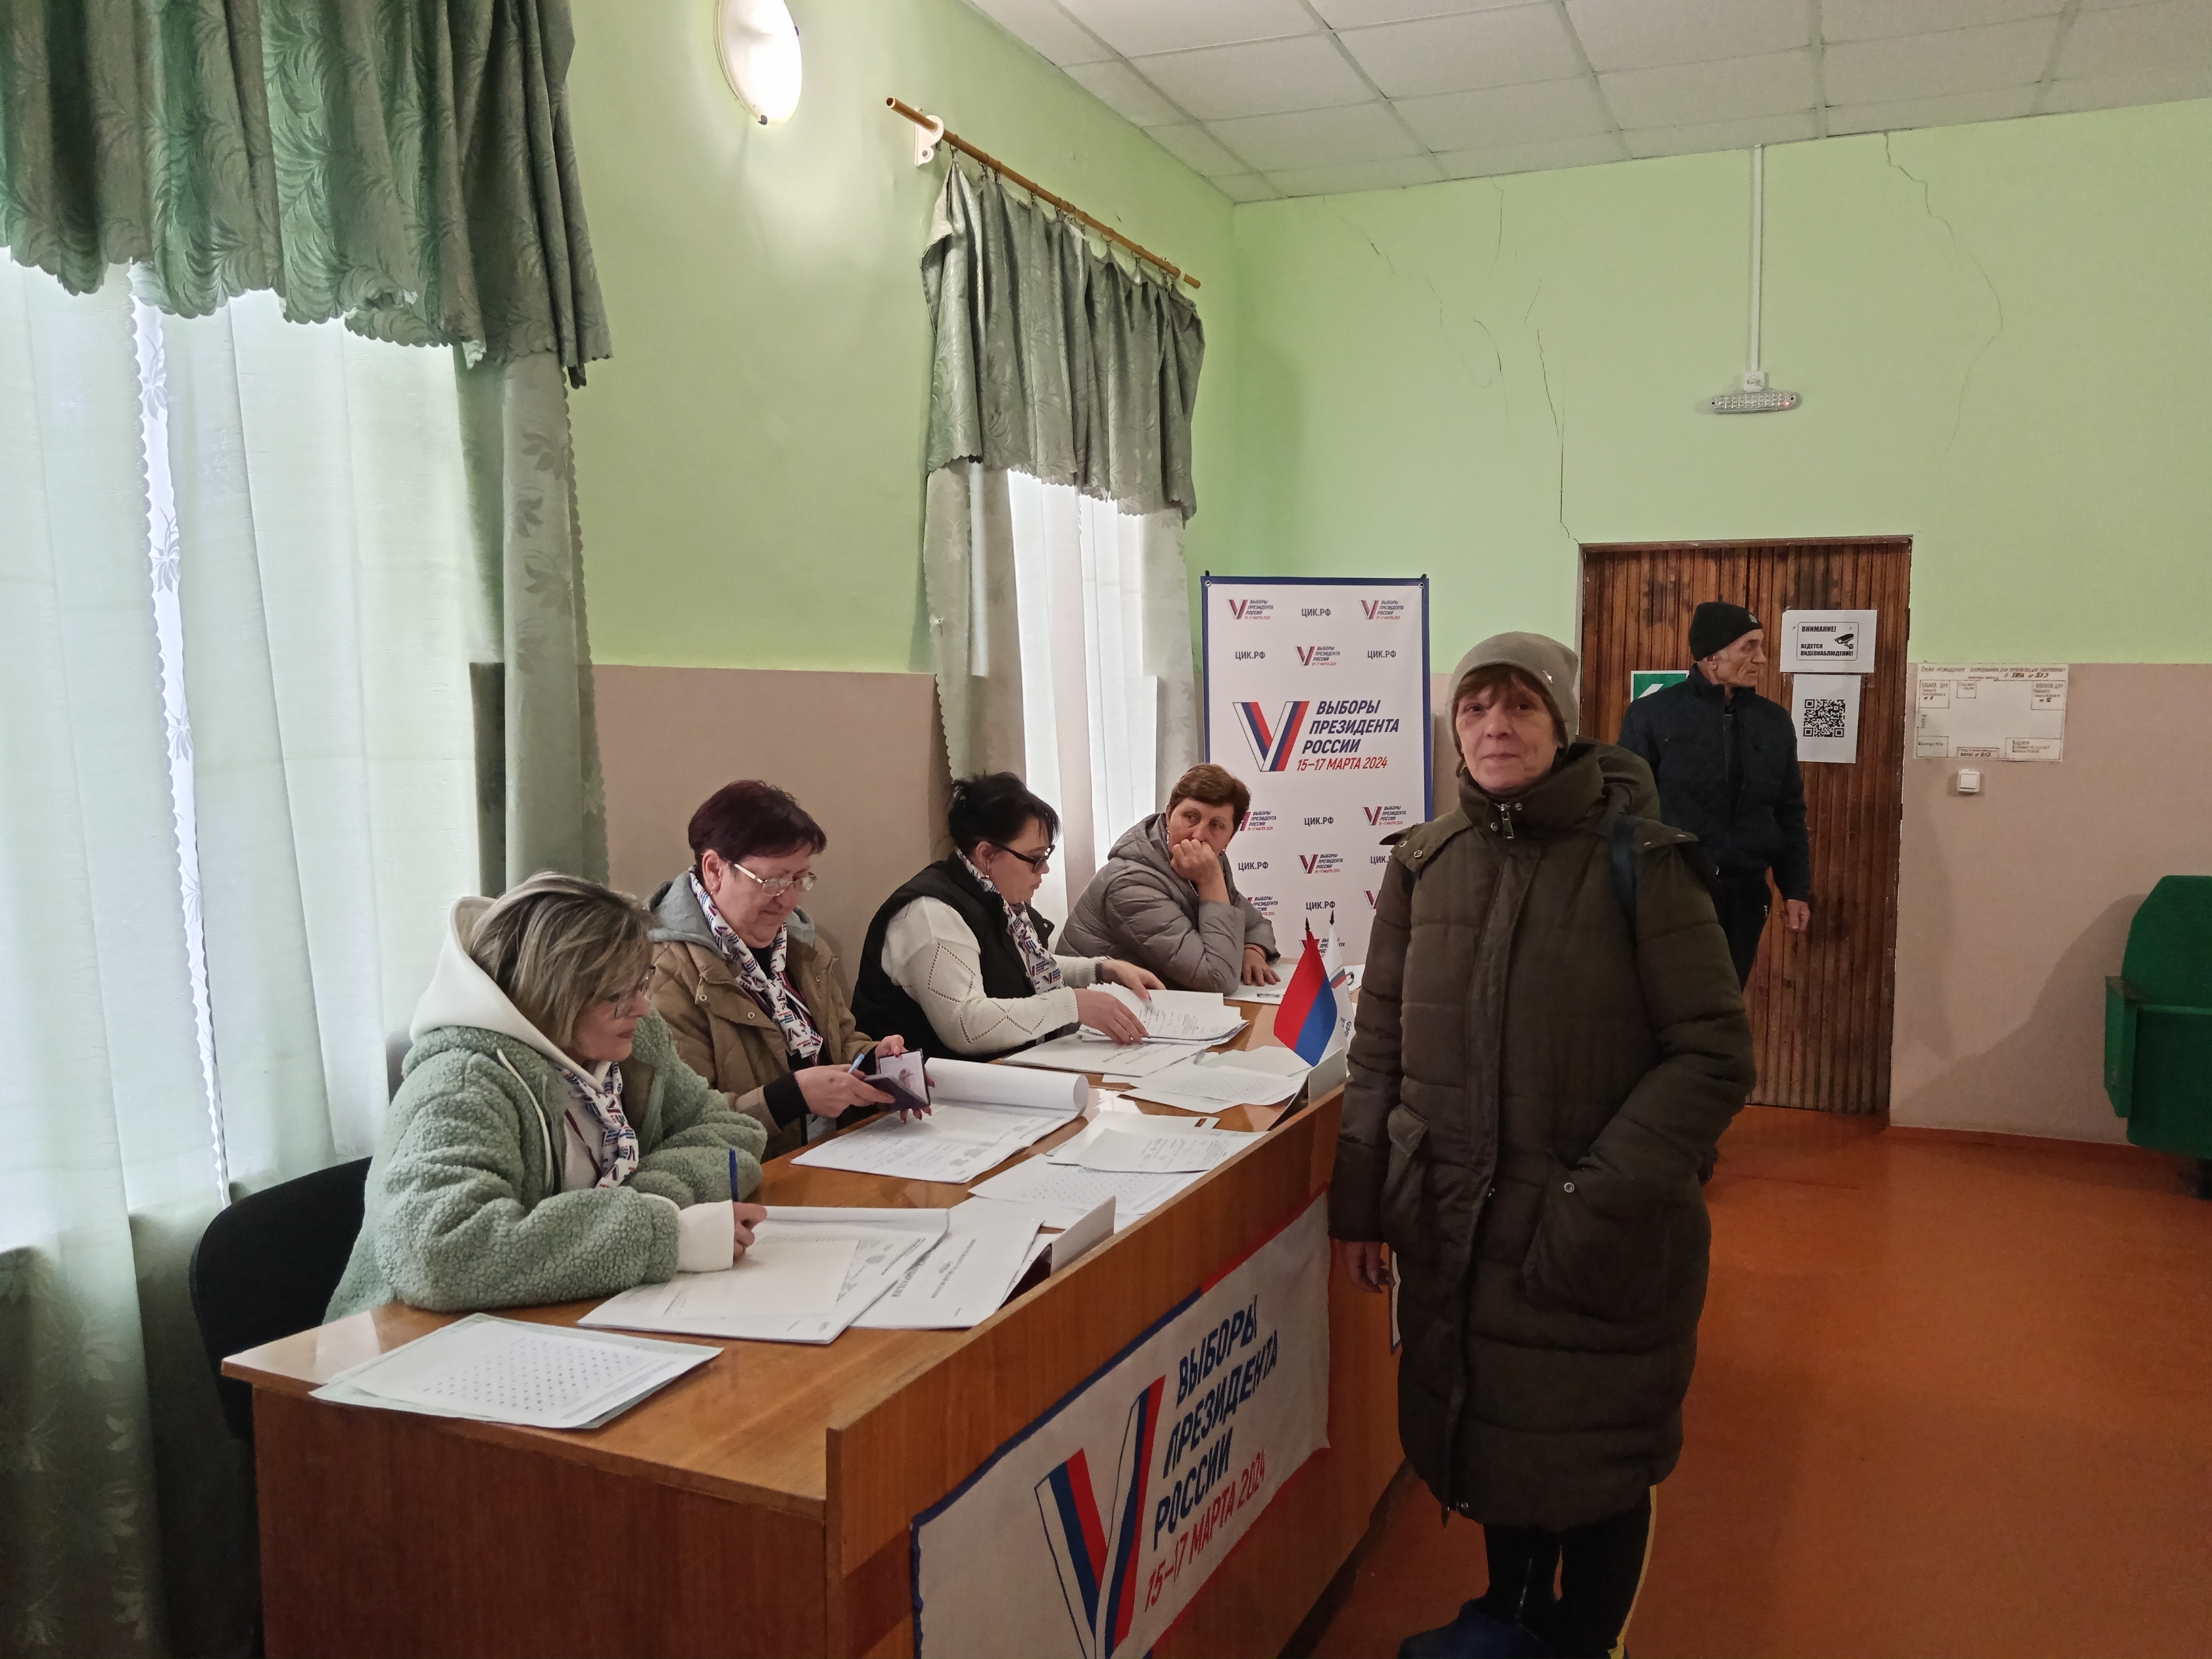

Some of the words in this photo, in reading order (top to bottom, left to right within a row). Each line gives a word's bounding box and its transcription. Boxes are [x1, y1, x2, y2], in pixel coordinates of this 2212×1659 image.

[1302, 608, 1331, 618] ЦИК.РФ
[1235, 651, 1265, 661] ЦИК.РФ
[1368, 650, 1396, 660] ЦИК.РФ
[1316, 700, 1381, 715] ВЫБОРЫ
[1309, 719, 1399, 735] ПРЕЗИДЕНТА
[1302, 739, 1361, 754] РОССИИ
[1326, 757, 1361, 770] МАРТА
[1362, 757, 1387, 769] 2024
[1304, 817, 1334, 826] ЦИК.РФ
[1238, 861, 1268, 872] ЦИК.РФ
[1371, 855, 1388, 865] ЦИК.
[1306, 901, 1335, 911] ЦИК.РФ
[1176, 1294, 1258, 1409] ВЫБОРЫ
[1163, 1329, 1278, 1479] ПРЕЗИДЕНТА
[1154, 1426, 1232, 1551] РОССИИ
[1188, 1481, 1236, 1565] МАРТА
[1237, 1446, 1265, 1509] 2024
